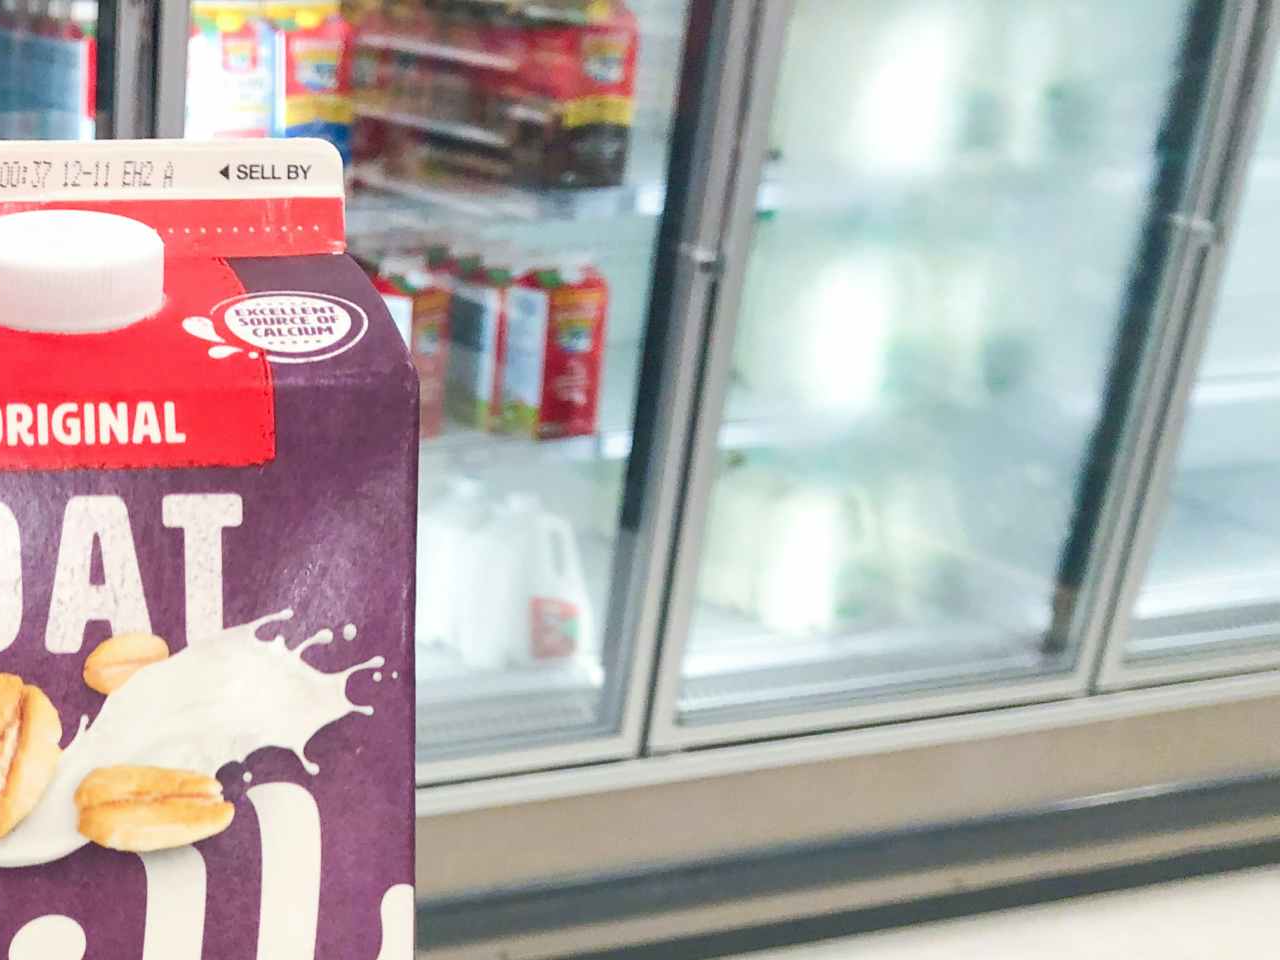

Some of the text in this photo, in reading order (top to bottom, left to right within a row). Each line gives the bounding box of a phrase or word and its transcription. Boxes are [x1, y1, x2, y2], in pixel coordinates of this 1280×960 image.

[62, 160, 110, 188] 12-11
[162, 160, 173, 189] A
[236, 163, 312, 181] SELL BY
[234, 304, 336, 317] EXCELLENT
[238, 314, 339, 328] SOURCE OF
[251, 325, 335, 338] CALCIUM
